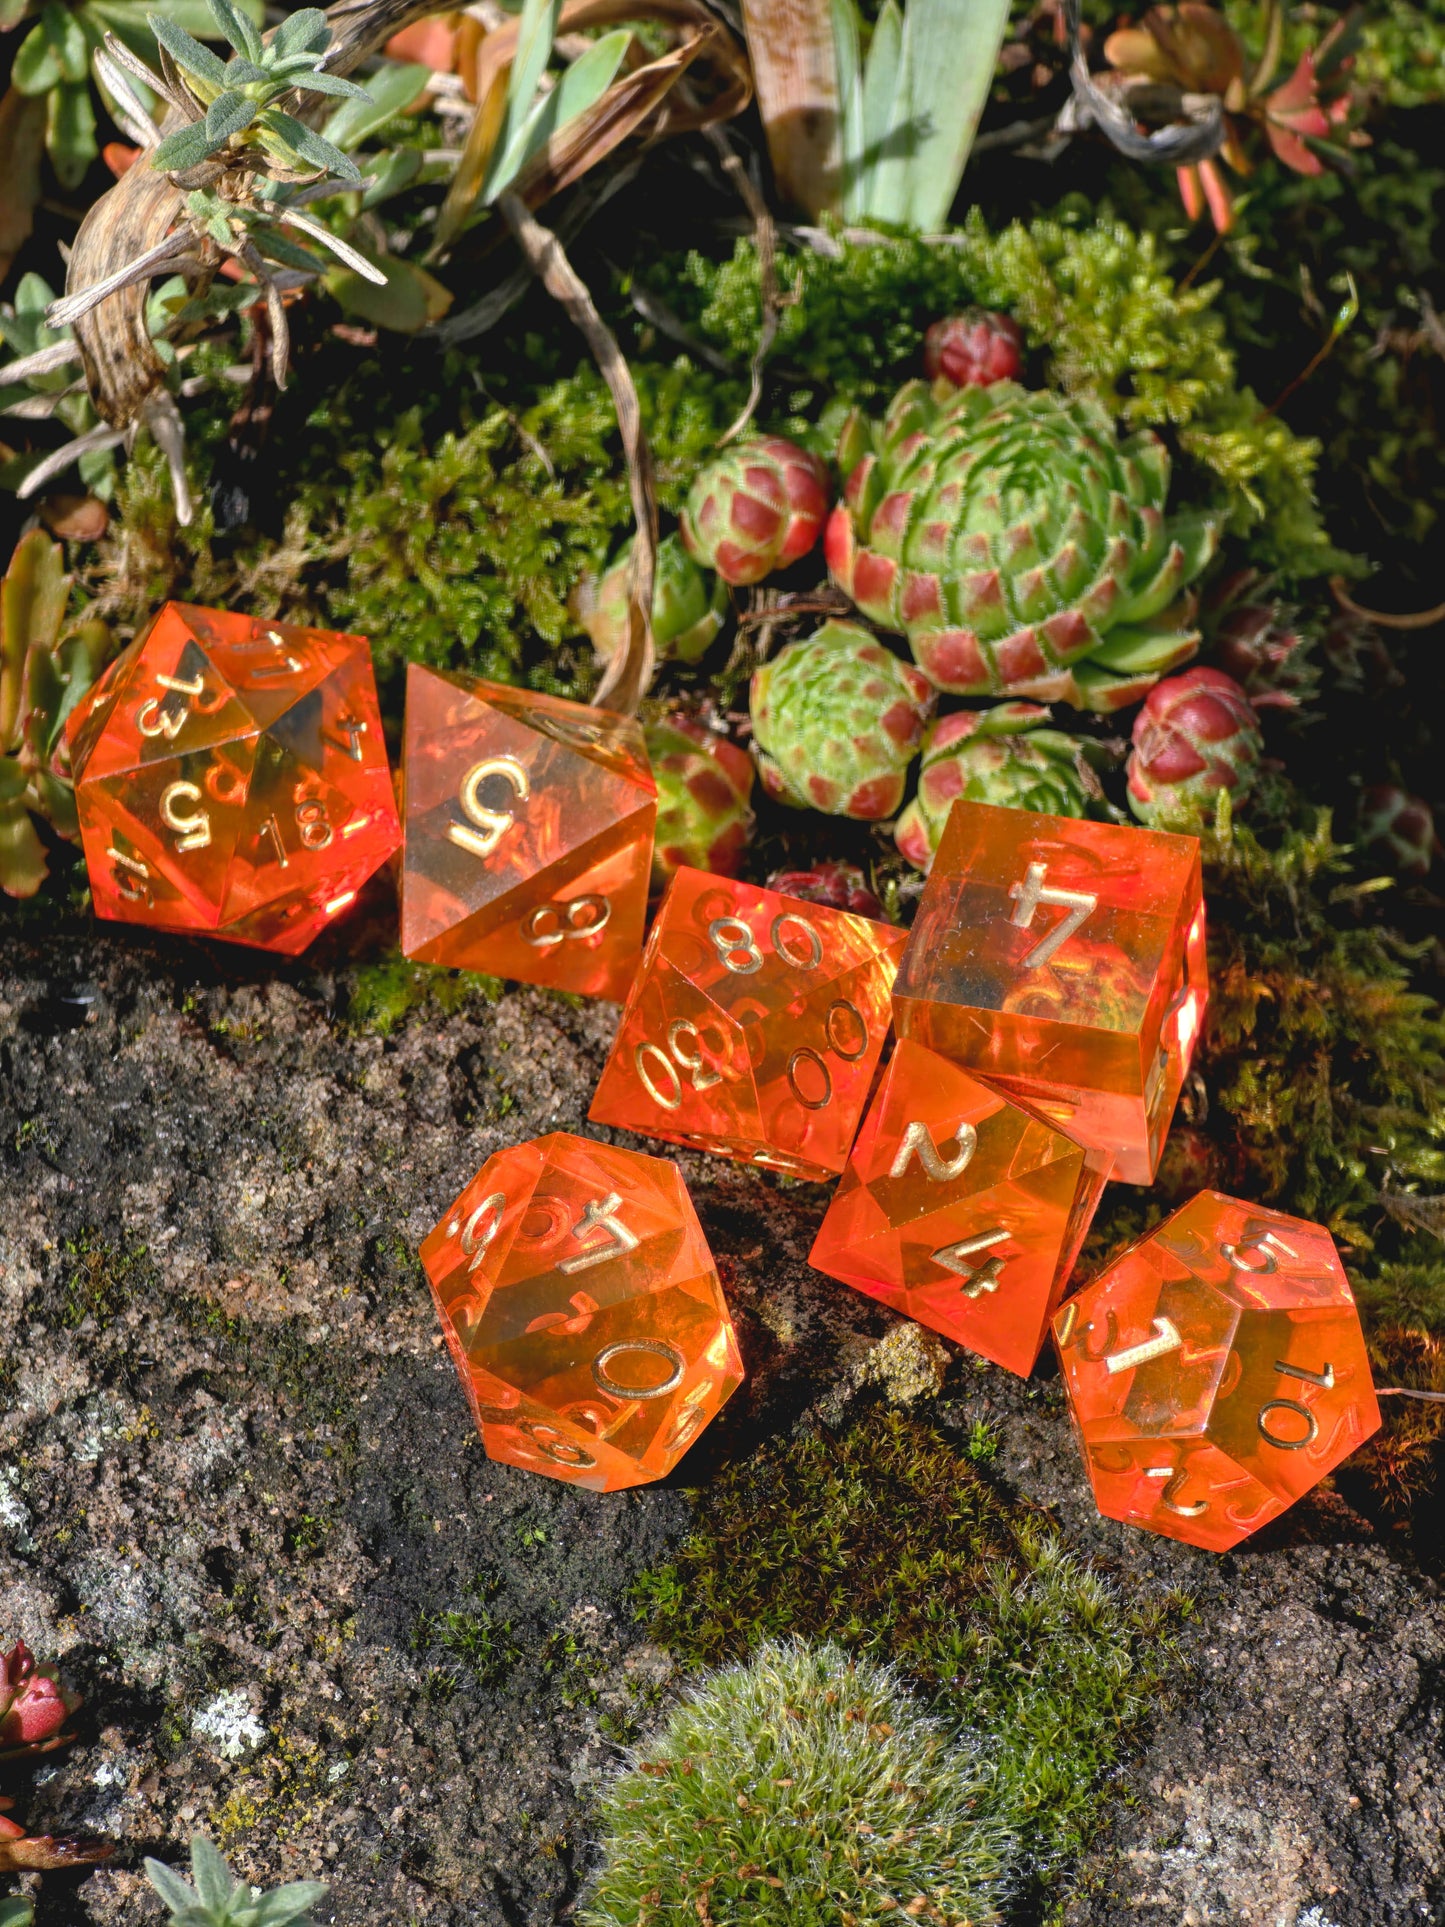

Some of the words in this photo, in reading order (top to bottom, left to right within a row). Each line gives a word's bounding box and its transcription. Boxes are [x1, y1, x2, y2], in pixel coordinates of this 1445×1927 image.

[135, 672, 204, 741] 13
[159, 780, 211, 852] 5
[260, 800, 332, 868] 18
[447, 754, 530, 859] 5
[520, 894, 612, 947] 8
[708, 912, 824, 975] 80
[1009, 861, 1098, 968] 4
[634, 1018, 723, 1112] 30
[889, 1121, 978, 1181] 2
[555, 1191, 641, 1276] 4
[930, 1229, 1013, 1299] 4
[1220, 1231, 1299, 1275] 5
[591, 1337, 686, 1400] 0
[1104, 1316, 1182, 1375] 1
[1257, 1361, 1335, 1450] 10
